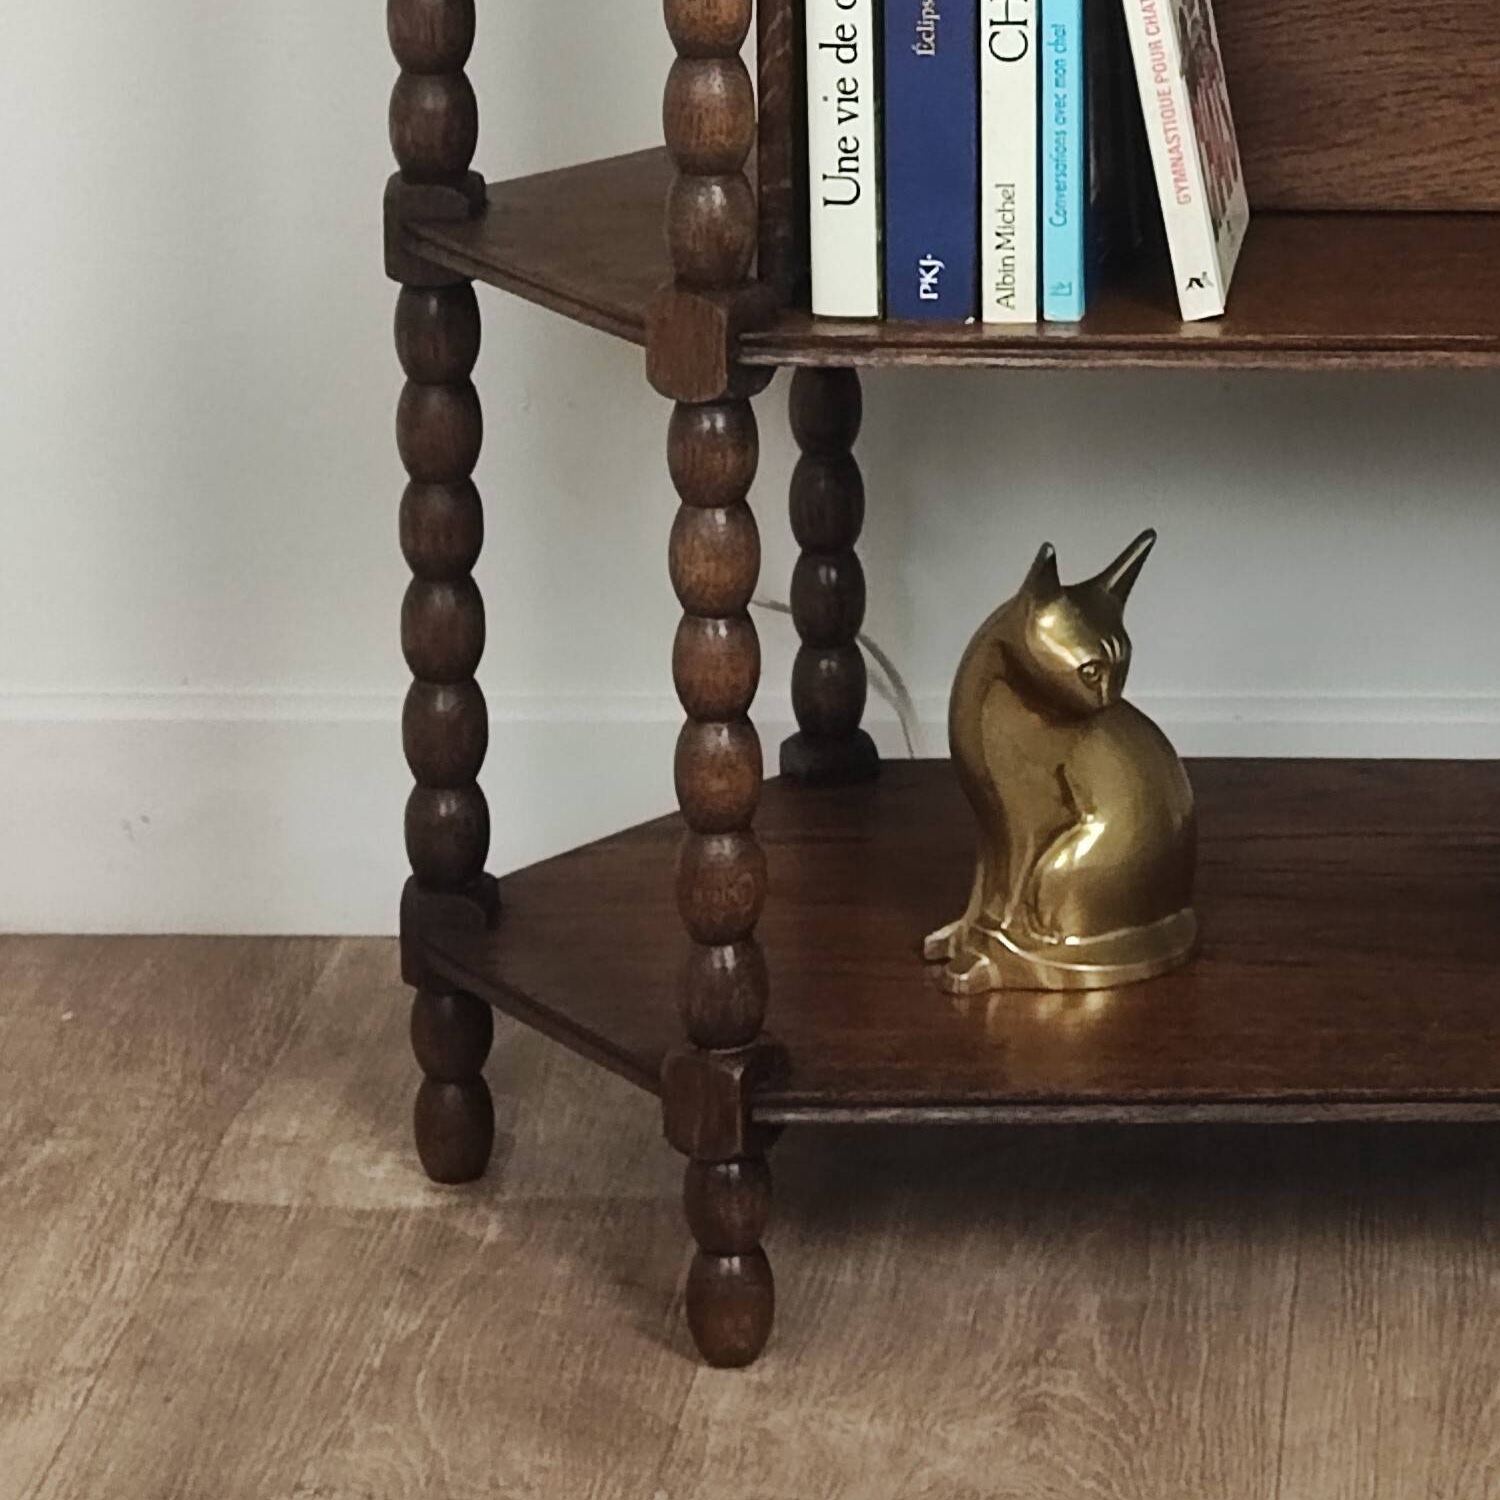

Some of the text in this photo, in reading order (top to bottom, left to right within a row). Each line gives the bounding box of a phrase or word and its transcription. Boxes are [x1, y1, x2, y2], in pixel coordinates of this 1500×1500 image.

[818, 23, 858, 64] de
[1148, 39, 1170, 84] POUR
[823, 76, 860, 126] vie
[1047, 23, 1068, 228] Conversations avec mon chat
[823, 136, 861, 207] Une
[1157, 88, 1192, 205] GYMNASTIQUE
[994, 183, 1016, 310] Albin Michel
